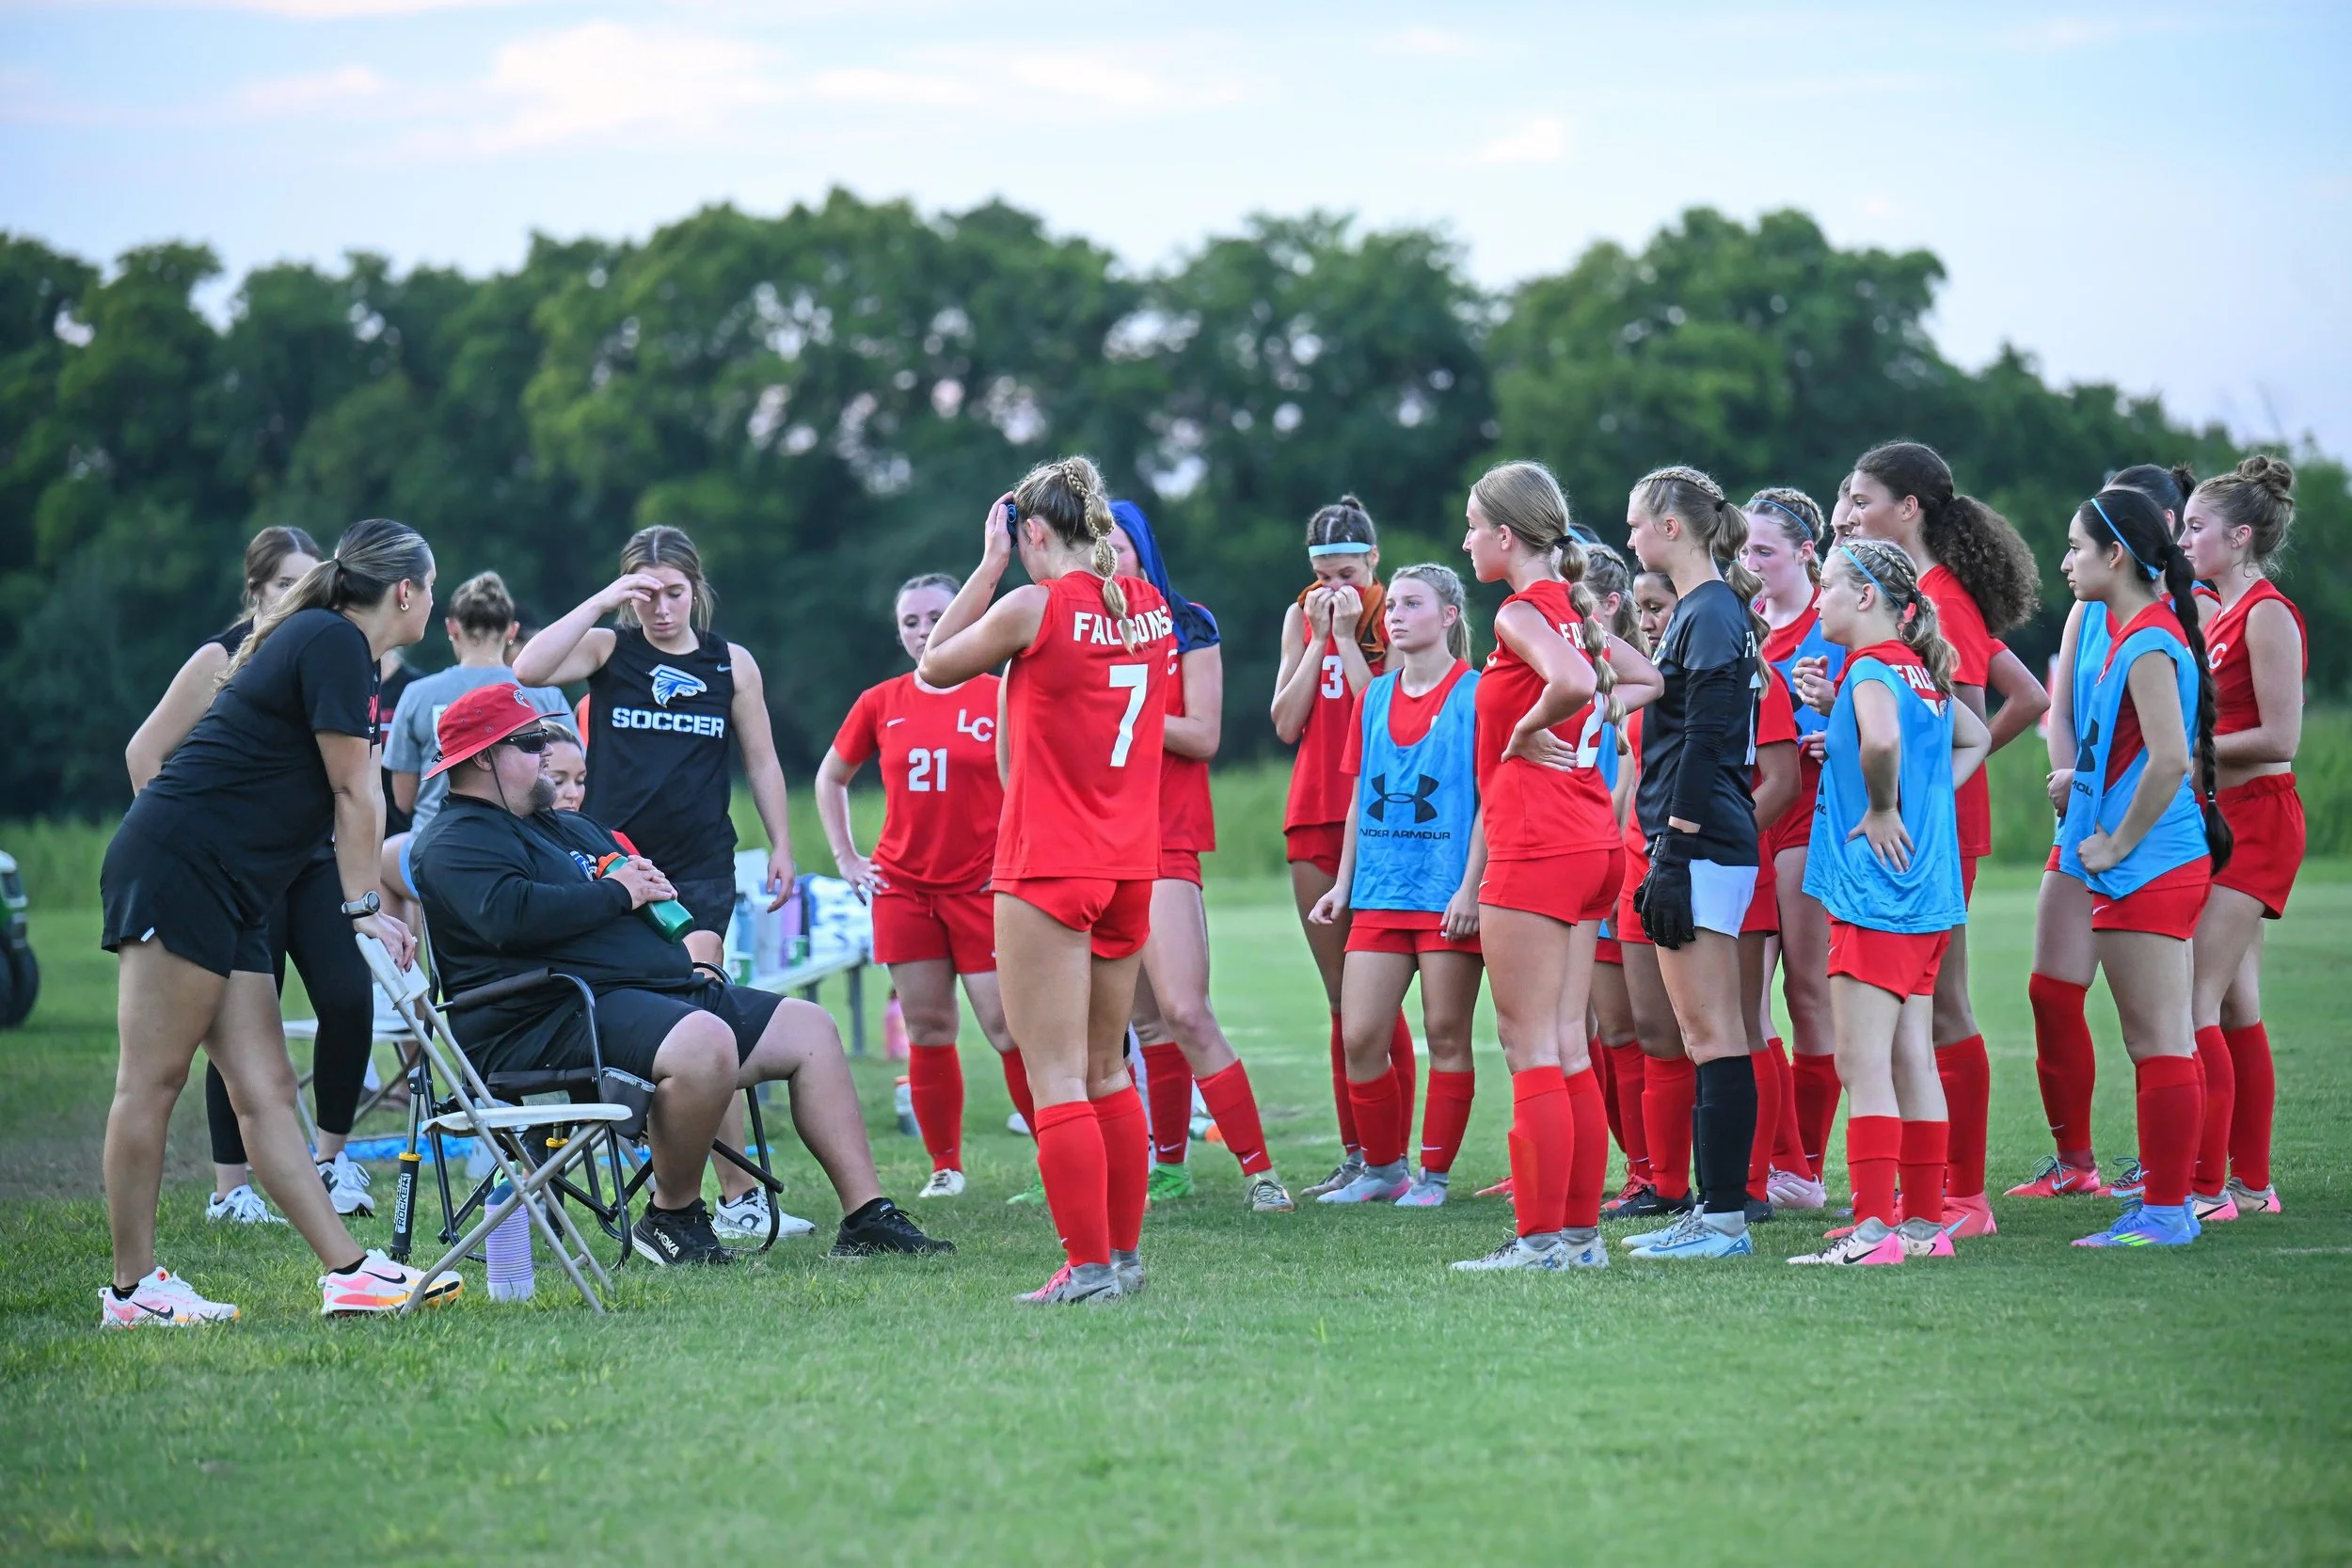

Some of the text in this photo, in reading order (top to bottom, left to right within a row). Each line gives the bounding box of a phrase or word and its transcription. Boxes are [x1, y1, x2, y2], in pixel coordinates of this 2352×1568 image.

[1073, 605, 1174, 646] FALCONS
[1321, 655, 1344, 699] 3
[612, 706, 724, 739] SOCCER
[957, 708, 995, 742] LC
[1108, 663, 1149, 768] 7
[908, 748, 947, 792] 21
[1359, 828, 1451, 840] NDER ARMOUR
[397, 1178, 409, 1227] ROCKER
[653, 1227, 680, 1259] HOKA
